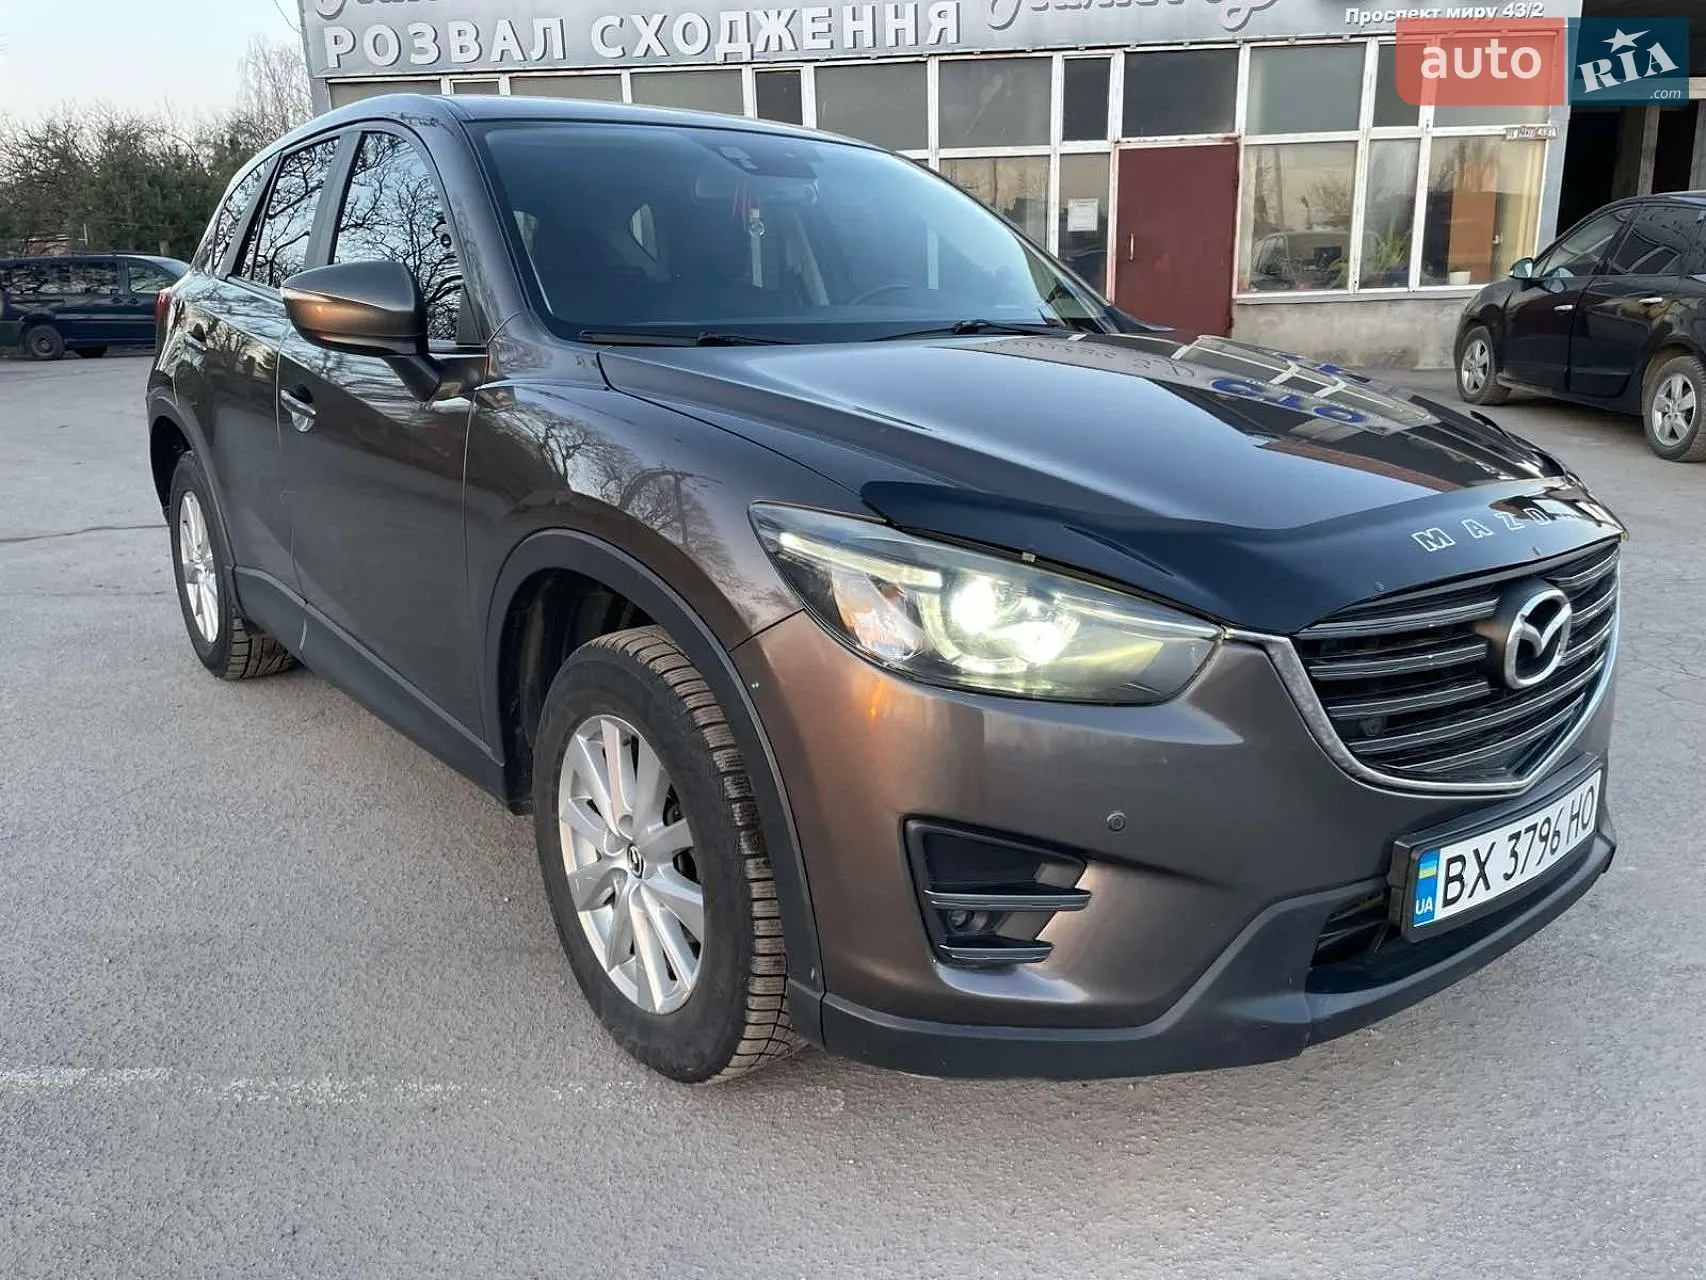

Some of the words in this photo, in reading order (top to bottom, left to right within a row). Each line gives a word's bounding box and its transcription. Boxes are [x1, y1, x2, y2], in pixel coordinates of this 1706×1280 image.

[323, 18, 569, 69] РОЗВАЛ
[591, 1, 961, 62] СХОДЖЕННЯ
[1345, 7, 1442, 27] Проспект
[1502, 2, 1545, 19] 43/2
[1411, 507, 1552, 552] MAZD
[1441, 840, 1497, 909] BX
[1502, 806, 1563, 882] 3796
[1415, 896, 1434, 915] UA
